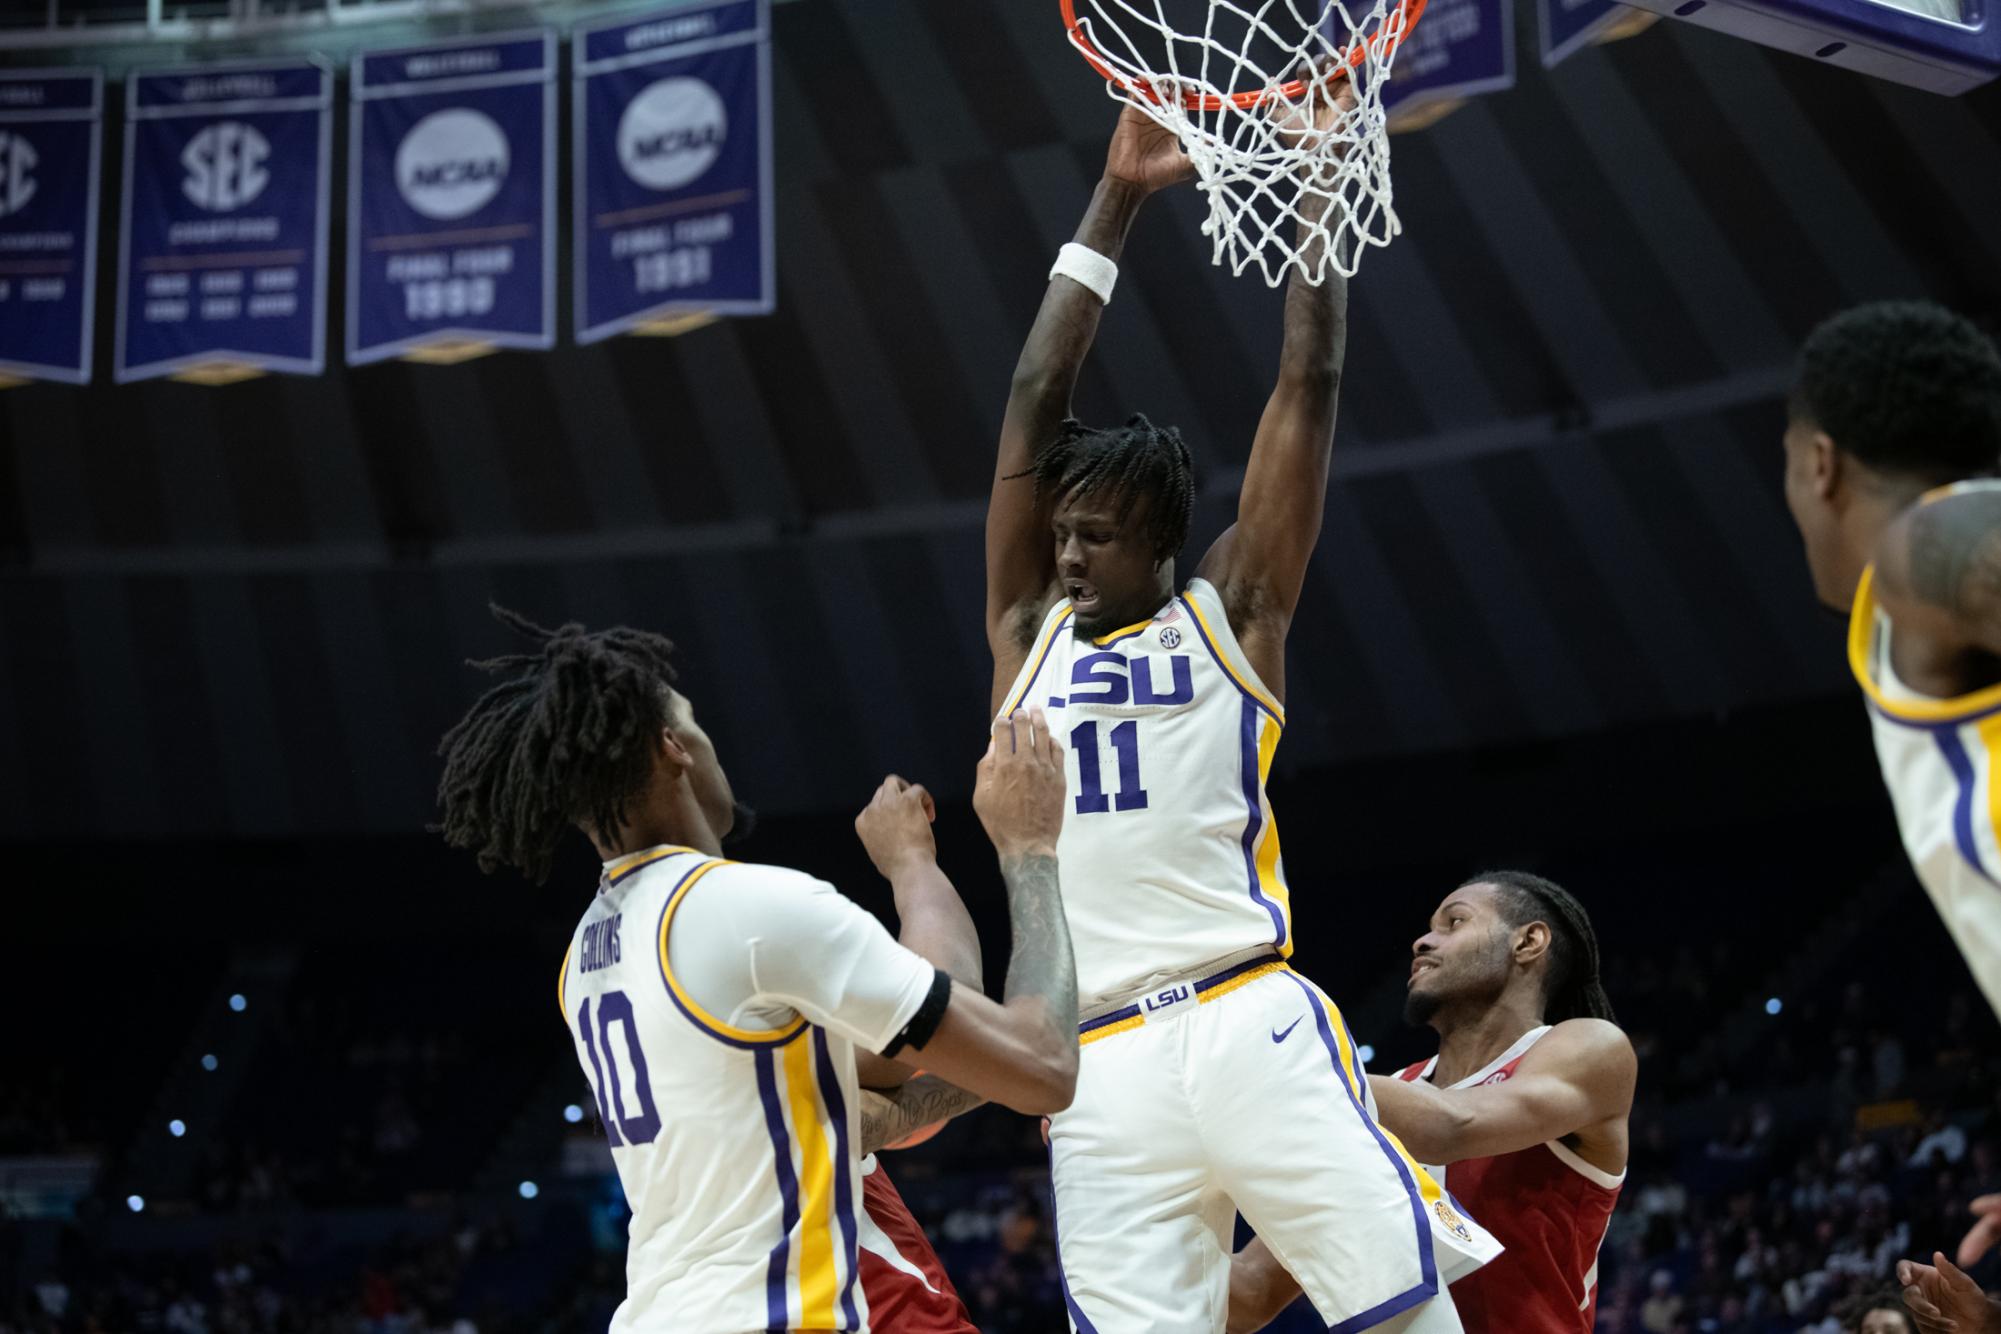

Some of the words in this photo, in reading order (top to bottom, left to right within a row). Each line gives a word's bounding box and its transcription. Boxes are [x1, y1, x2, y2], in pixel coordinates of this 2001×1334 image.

[181, 121, 271, 211] SEC
[634, 123, 723, 160] NCAA
[409, 157, 507, 187] NCAA
[1160, 627, 1181, 648] SEC
[1070, 720, 1149, 815] 11
[580, 912, 623, 974] COLLINS
[1145, 985, 1189, 1012] LSU
[578, 990, 662, 1148] 10
